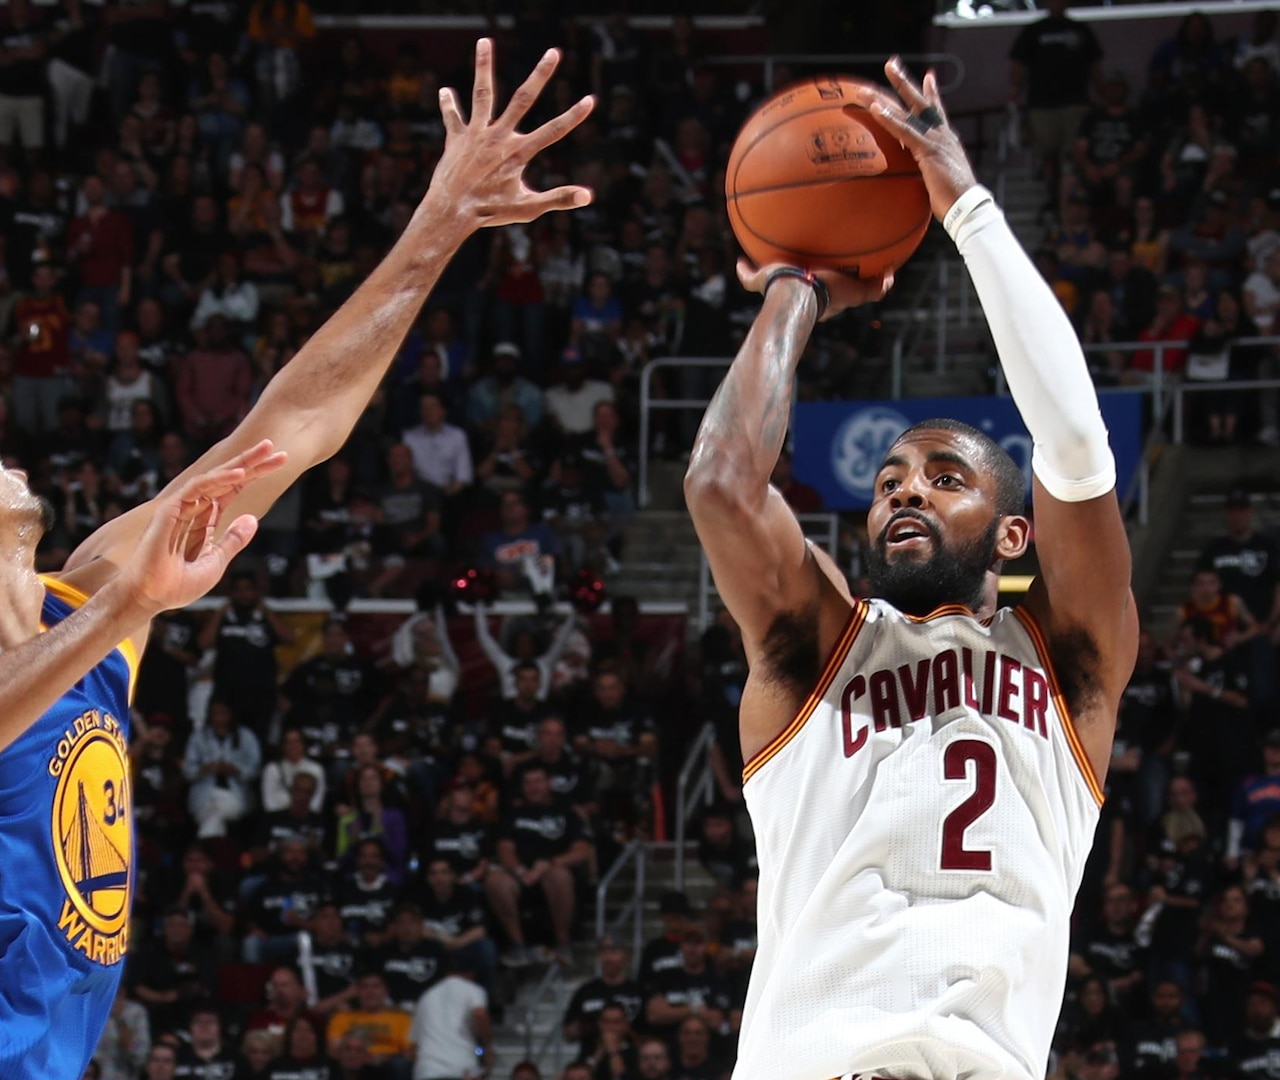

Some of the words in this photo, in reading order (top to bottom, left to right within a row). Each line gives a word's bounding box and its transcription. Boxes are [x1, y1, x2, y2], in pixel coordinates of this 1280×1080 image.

[48, 709, 101, 778] GOLDEN
[841, 647, 1051, 758] CAVALIER
[940, 736, 998, 873] 2
